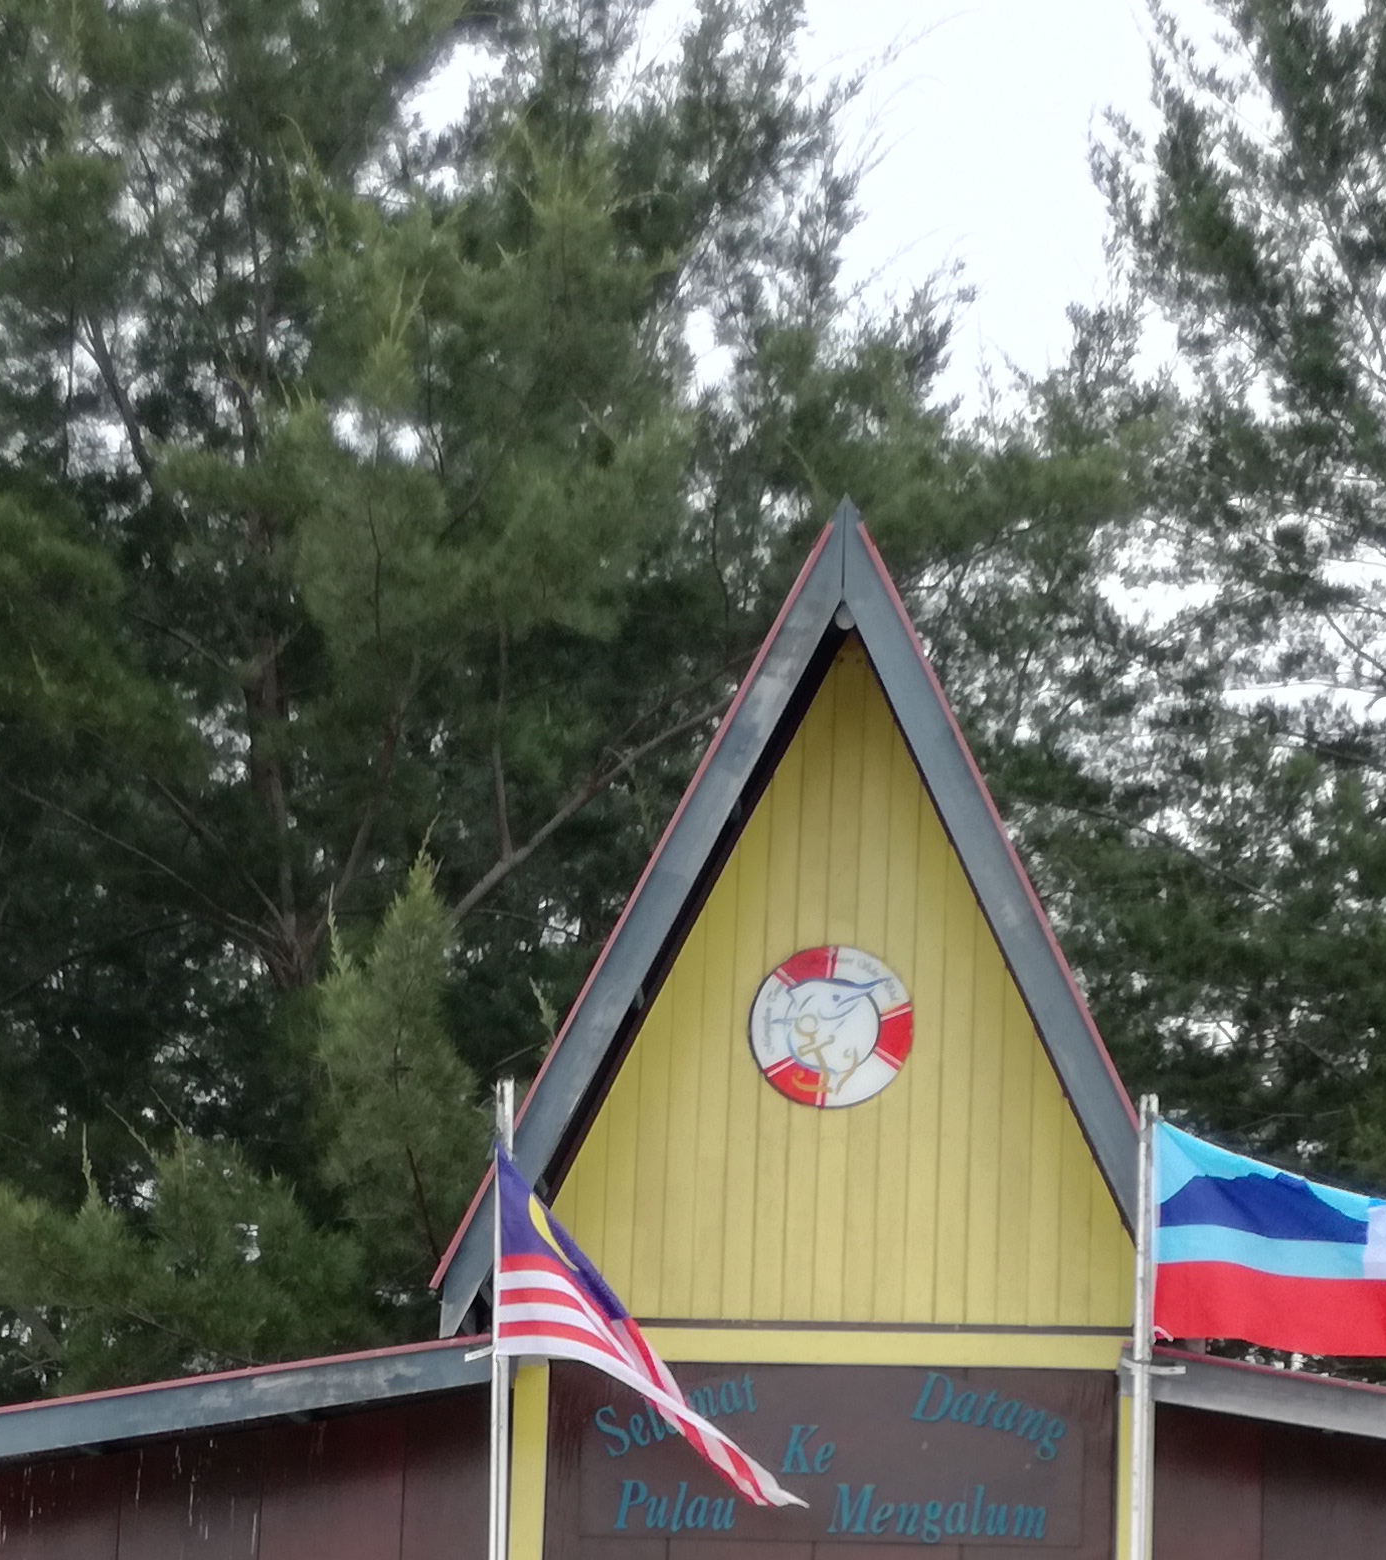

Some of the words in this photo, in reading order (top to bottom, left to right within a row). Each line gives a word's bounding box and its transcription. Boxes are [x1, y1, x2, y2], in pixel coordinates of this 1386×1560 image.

[590, 1373, 758, 1458] Selmat
[911, 1371, 1068, 1461] Datang
[779, 1424, 836, 1474] Ke
[615, 1479, 736, 1532] Pulau
[826, 1482, 1046, 1544] Mengalum
